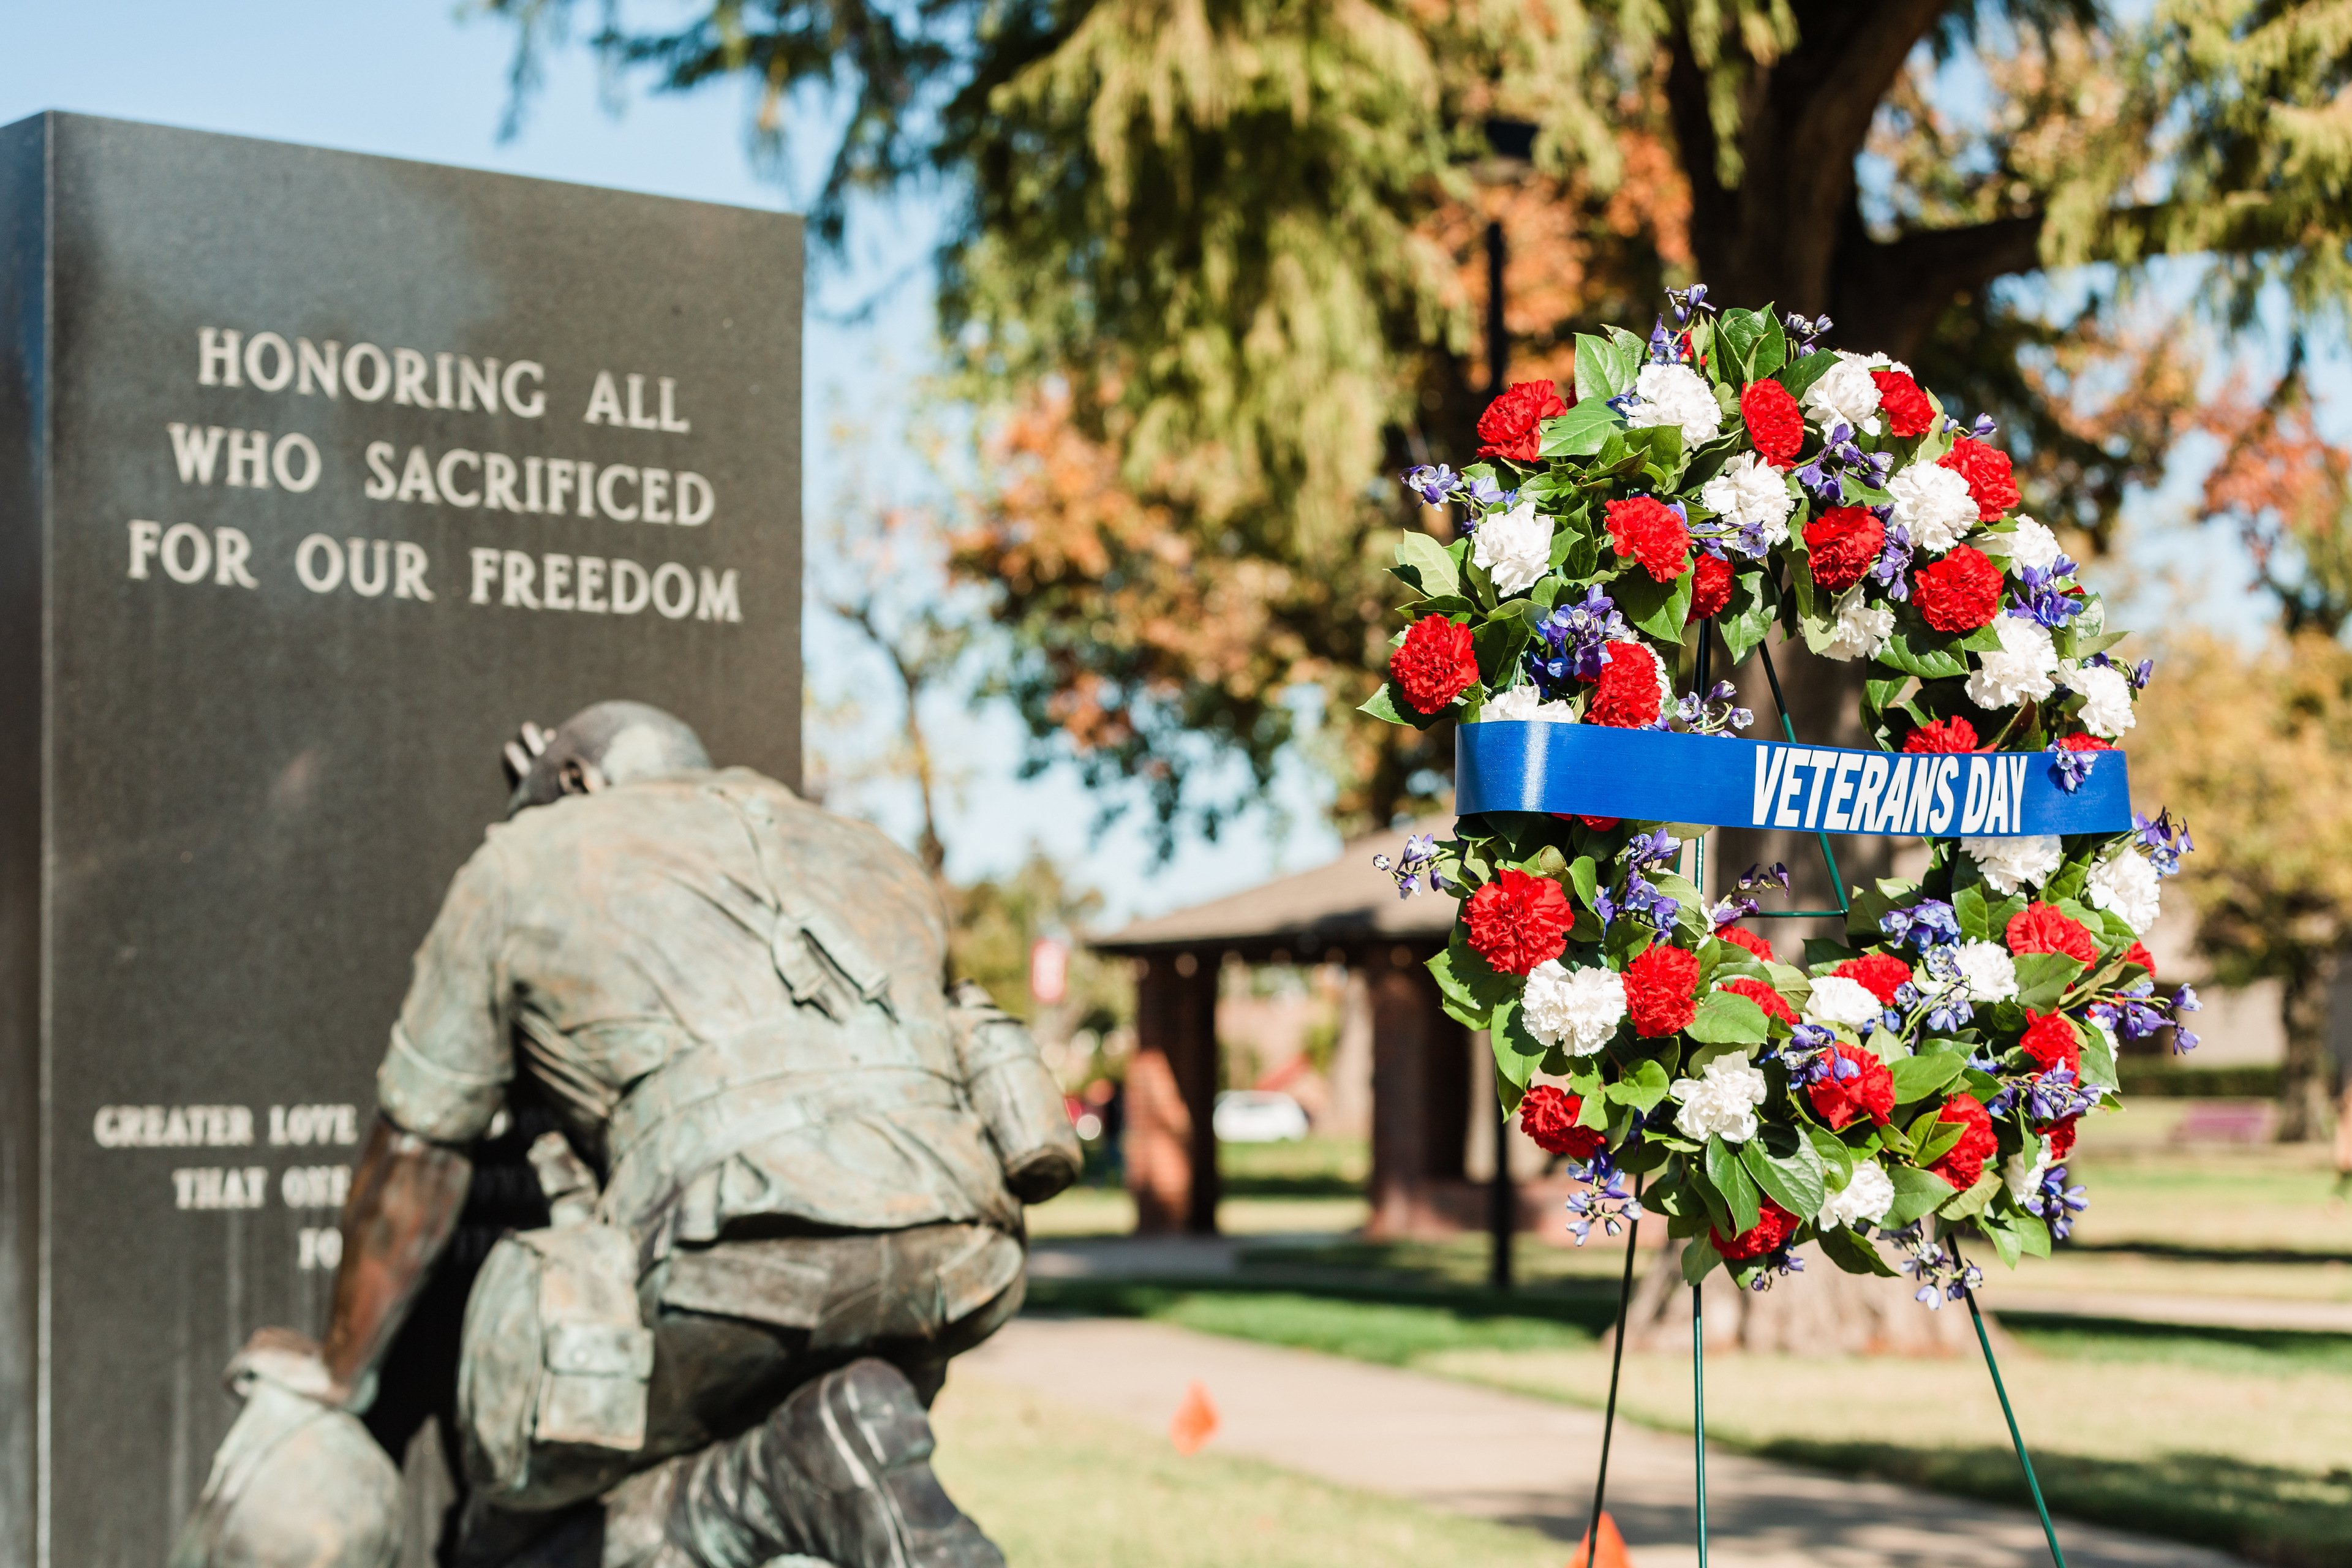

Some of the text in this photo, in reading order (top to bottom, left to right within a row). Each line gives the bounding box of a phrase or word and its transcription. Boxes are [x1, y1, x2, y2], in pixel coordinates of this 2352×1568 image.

[197, 325, 691, 434] HONORING ALL
[168, 422, 716, 528] WHO SACRIFICED
[127, 519, 743, 623] FOR OUR FREEDOM
[1752, 745, 2028, 834] VETERANS DAY
[93, 1104, 358, 1148] GREATER LOVE
[173, 1165, 352, 1210] THAT ONE
[297, 1227, 344, 1271] FO
